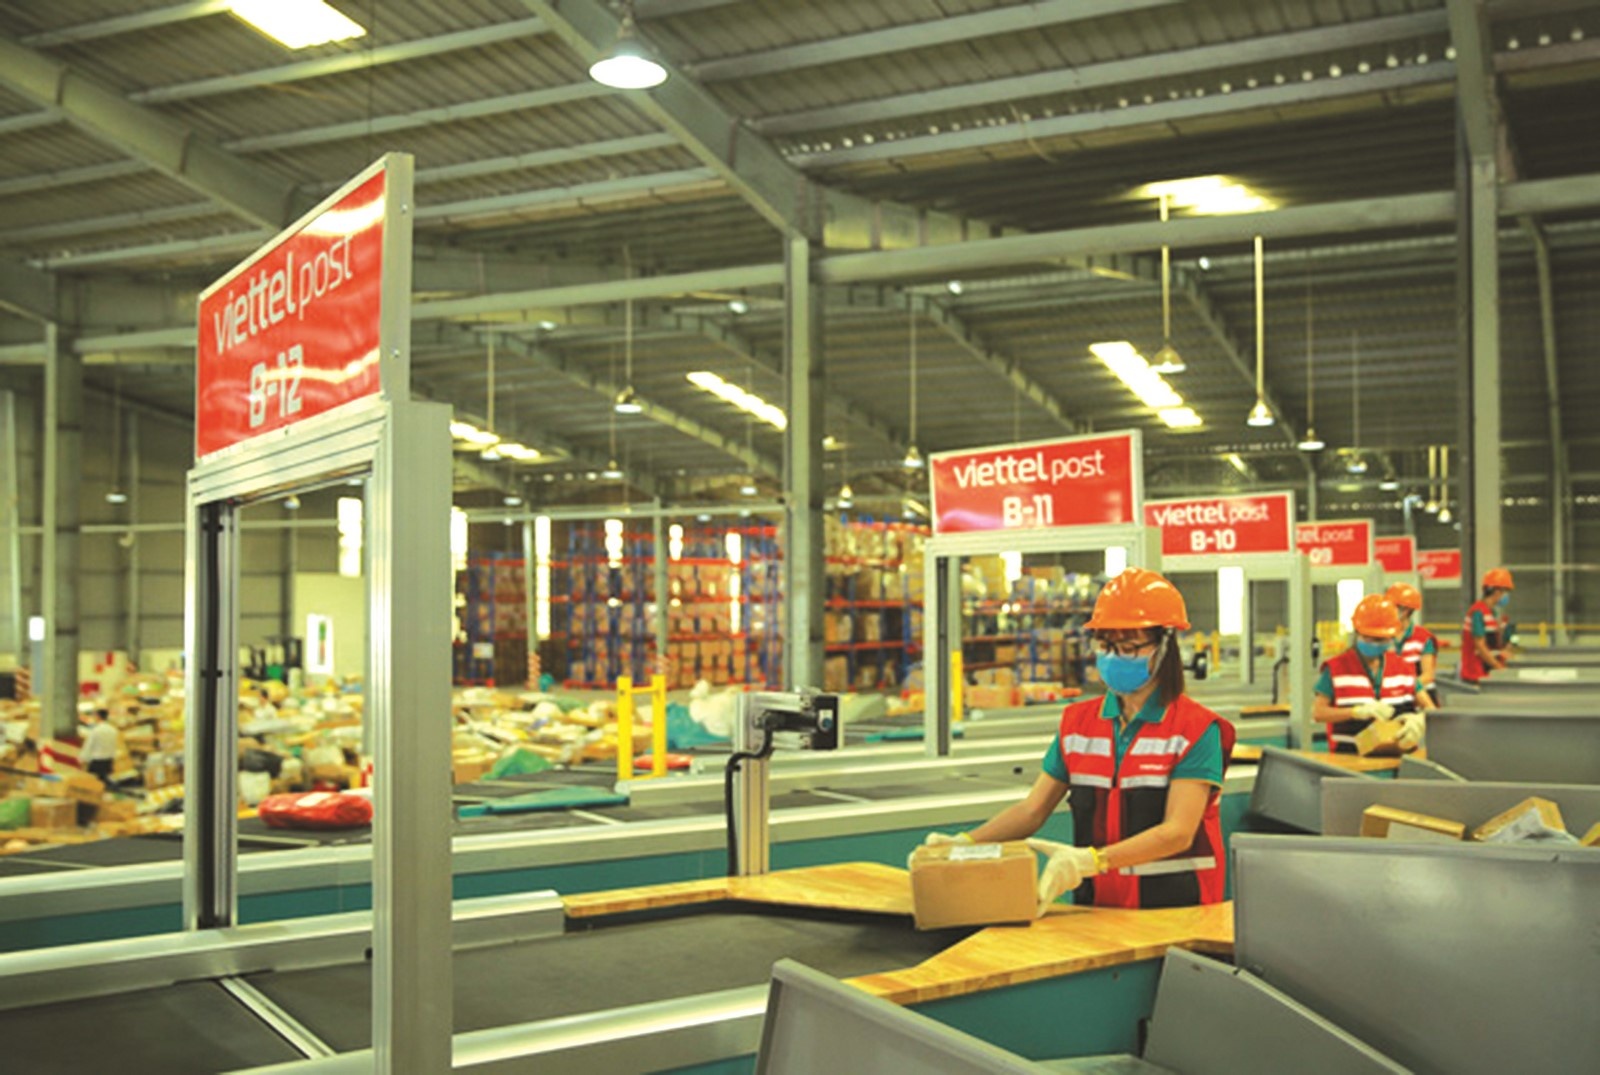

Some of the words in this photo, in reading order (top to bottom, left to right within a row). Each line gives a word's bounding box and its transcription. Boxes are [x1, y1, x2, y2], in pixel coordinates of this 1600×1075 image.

[214, 251, 296, 355] viettel
[299, 235, 353, 321] post
[249, 344, 304, 428] B-12
[953, 452, 1048, 488] viettel
[1052, 450, 1105, 485] post
[1003, 494, 1053, 527] B-11
[1153, 503, 1227, 526] viettel
[1229, 502, 1270, 525] post
[1190, 529, 1237, 551] B-10
[1295, 526, 1320, 543] tel
[1321, 527, 1354, 544] post
